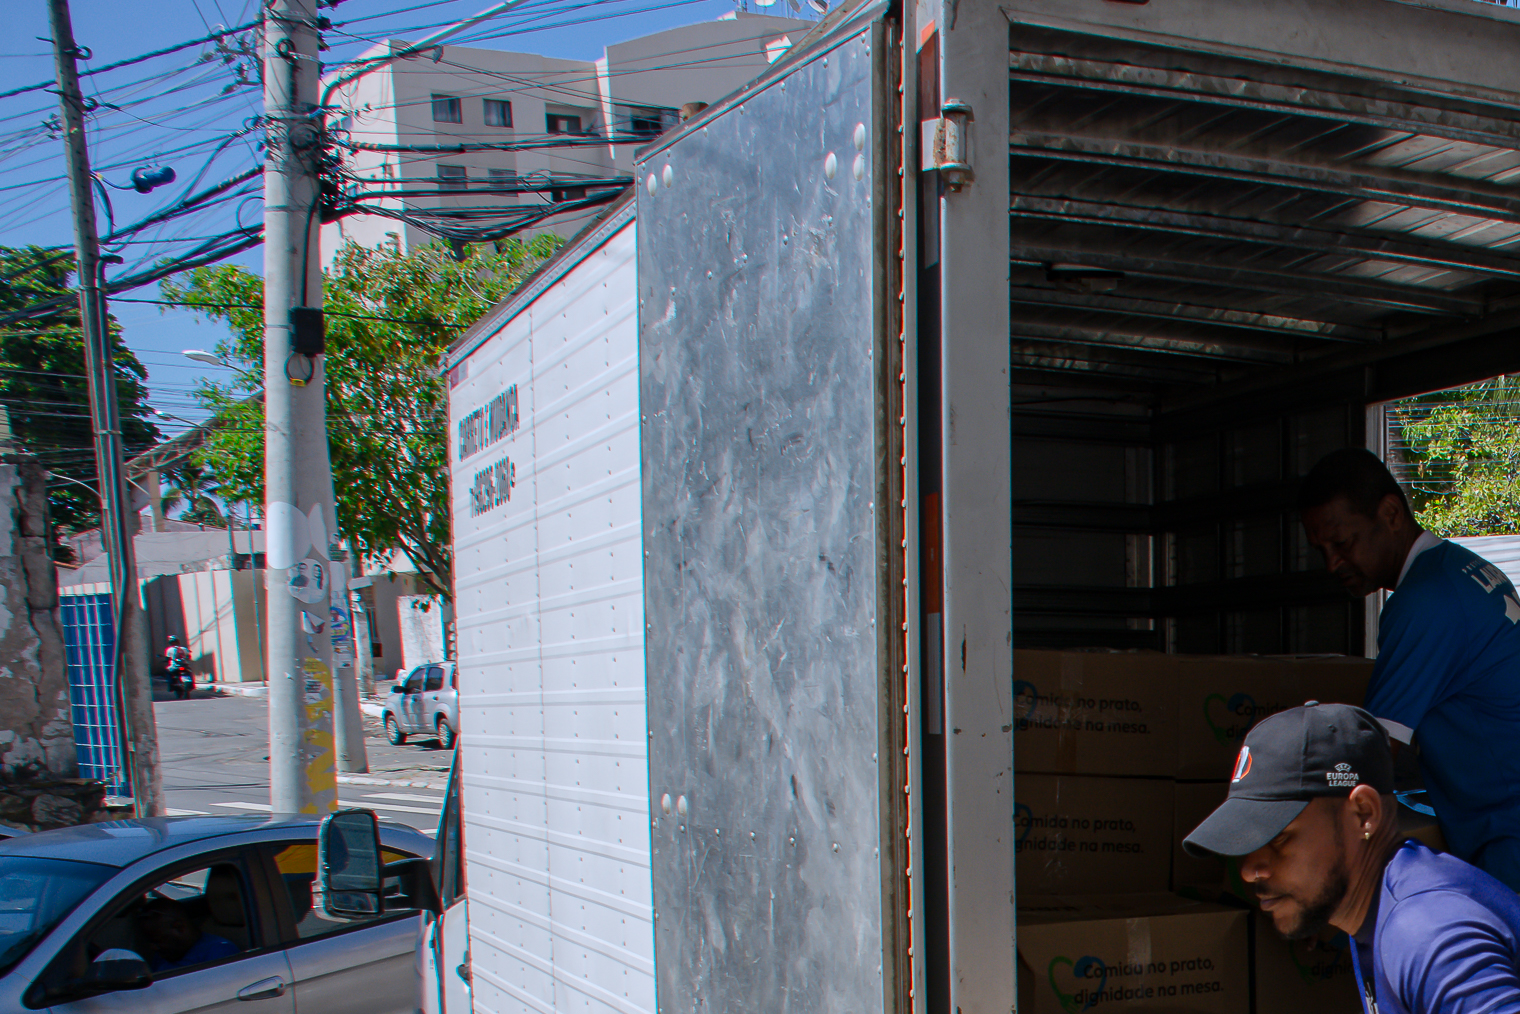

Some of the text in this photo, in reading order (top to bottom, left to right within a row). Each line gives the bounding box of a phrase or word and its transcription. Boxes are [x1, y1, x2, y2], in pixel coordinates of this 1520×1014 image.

[1077, 698, 1096, 709] no
[1098, 698, 1142, 713] prato,
[1086, 719, 1104, 732] na
[1108, 722, 1151, 735] mesa.
[1326, 772, 1360, 781] EUROPA
[1072, 818, 1090, 830] no
[1094, 818, 1137, 833] prato,
[1080, 840, 1098, 852] na
[1101, 842, 1144, 854] mesa.
[1084, 957, 1215, 979] Comida no prato,
[1074, 981, 1225, 1007] dignidade na mesa.
